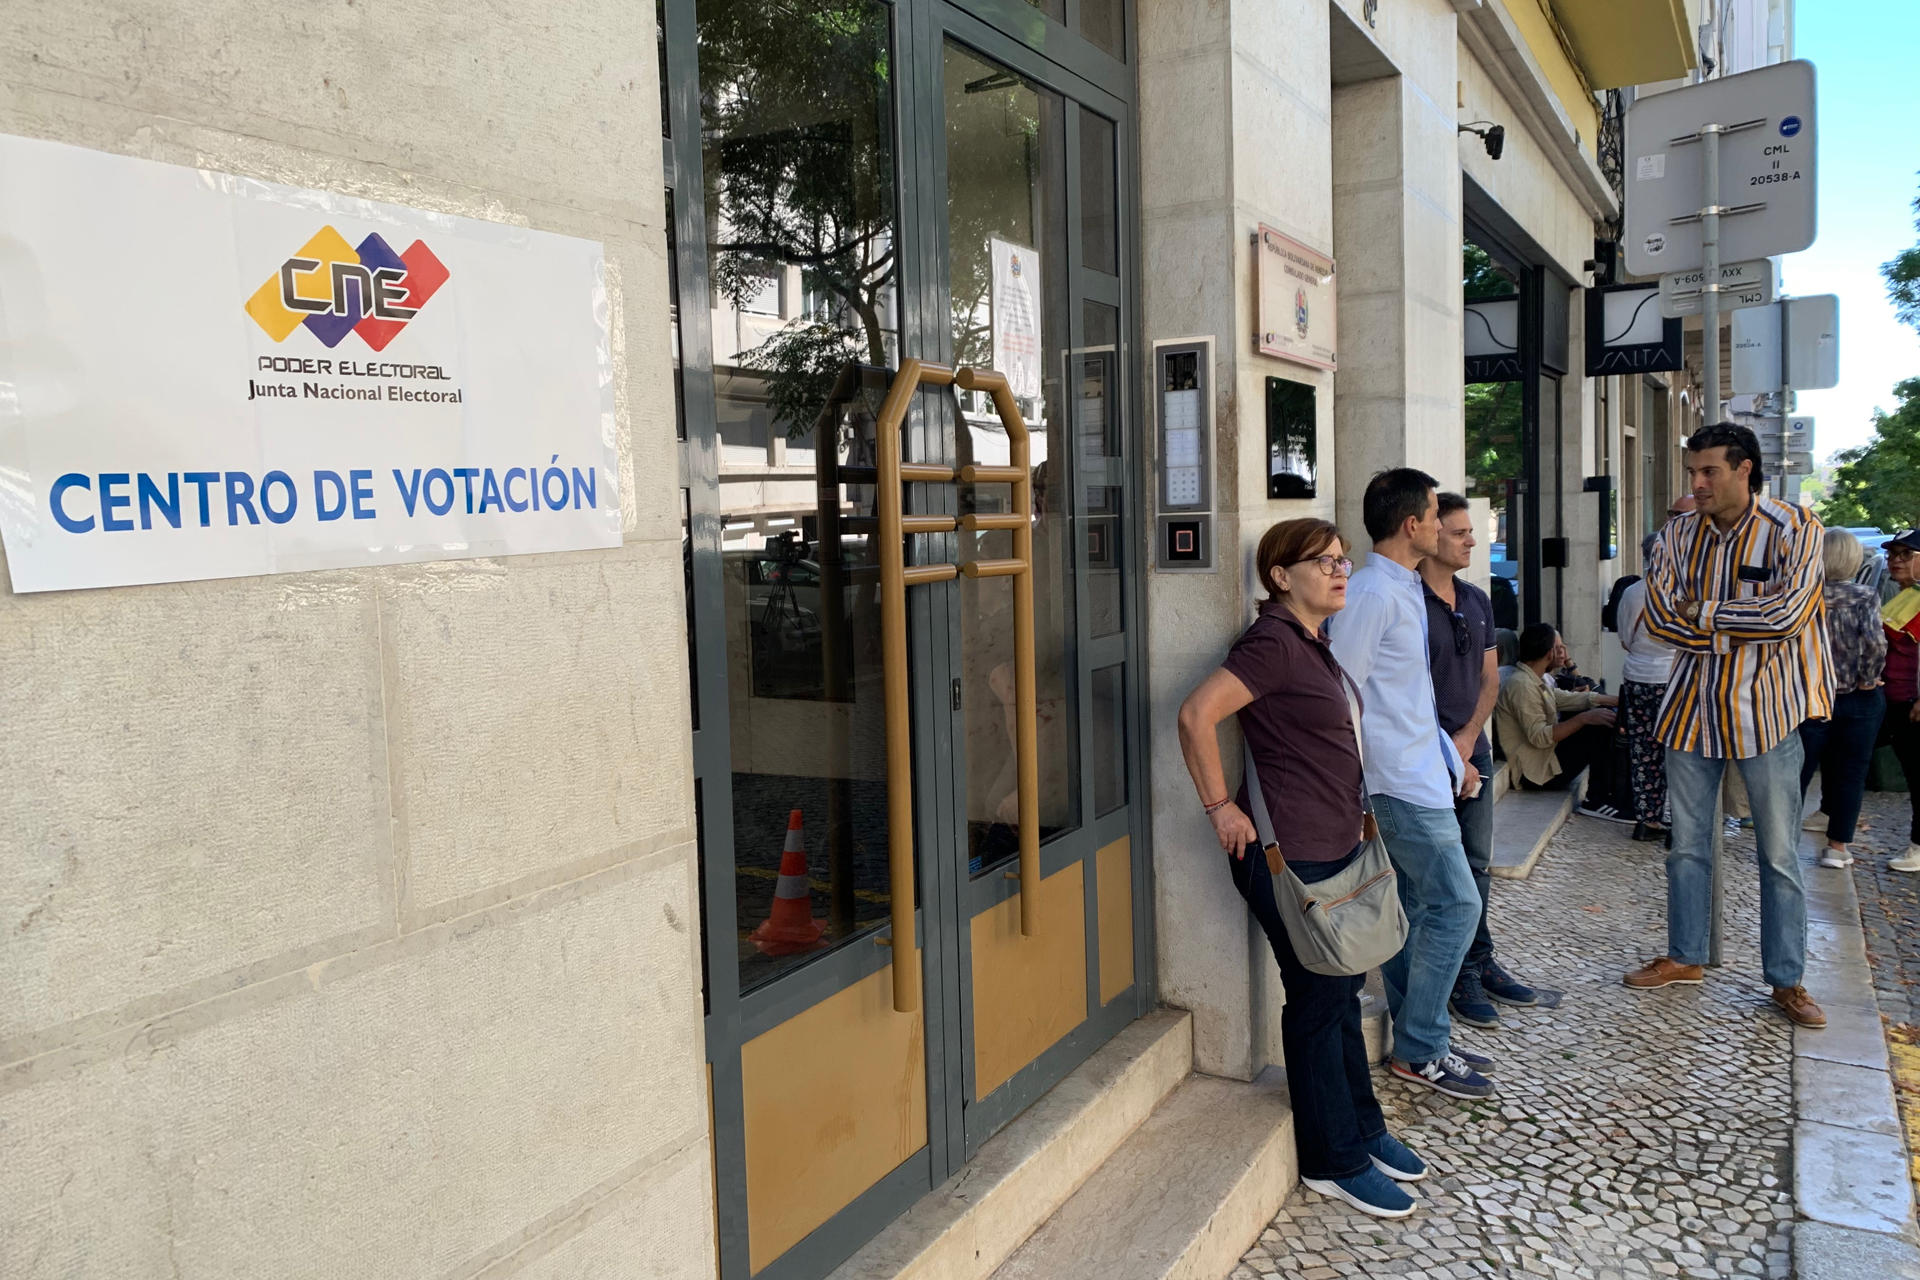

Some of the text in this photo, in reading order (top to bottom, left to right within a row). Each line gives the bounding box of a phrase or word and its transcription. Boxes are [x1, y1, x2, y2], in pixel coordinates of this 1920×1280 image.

[1763, 144, 1790, 156] CML
[1750, 170, 1801, 186] 20538-A
[1721, 266, 1743, 279] XXV
[281, 258, 418, 319] CNE
[1738, 292, 1763, 304] CML
[258, 355, 452, 381] PODER ELECTORAL
[1594, 348, 1673, 370] SALTA
[247, 379, 463, 404] Junta Nacional Electoral
[49, 453, 598, 535] CENTRO DE VOTACIÓN
